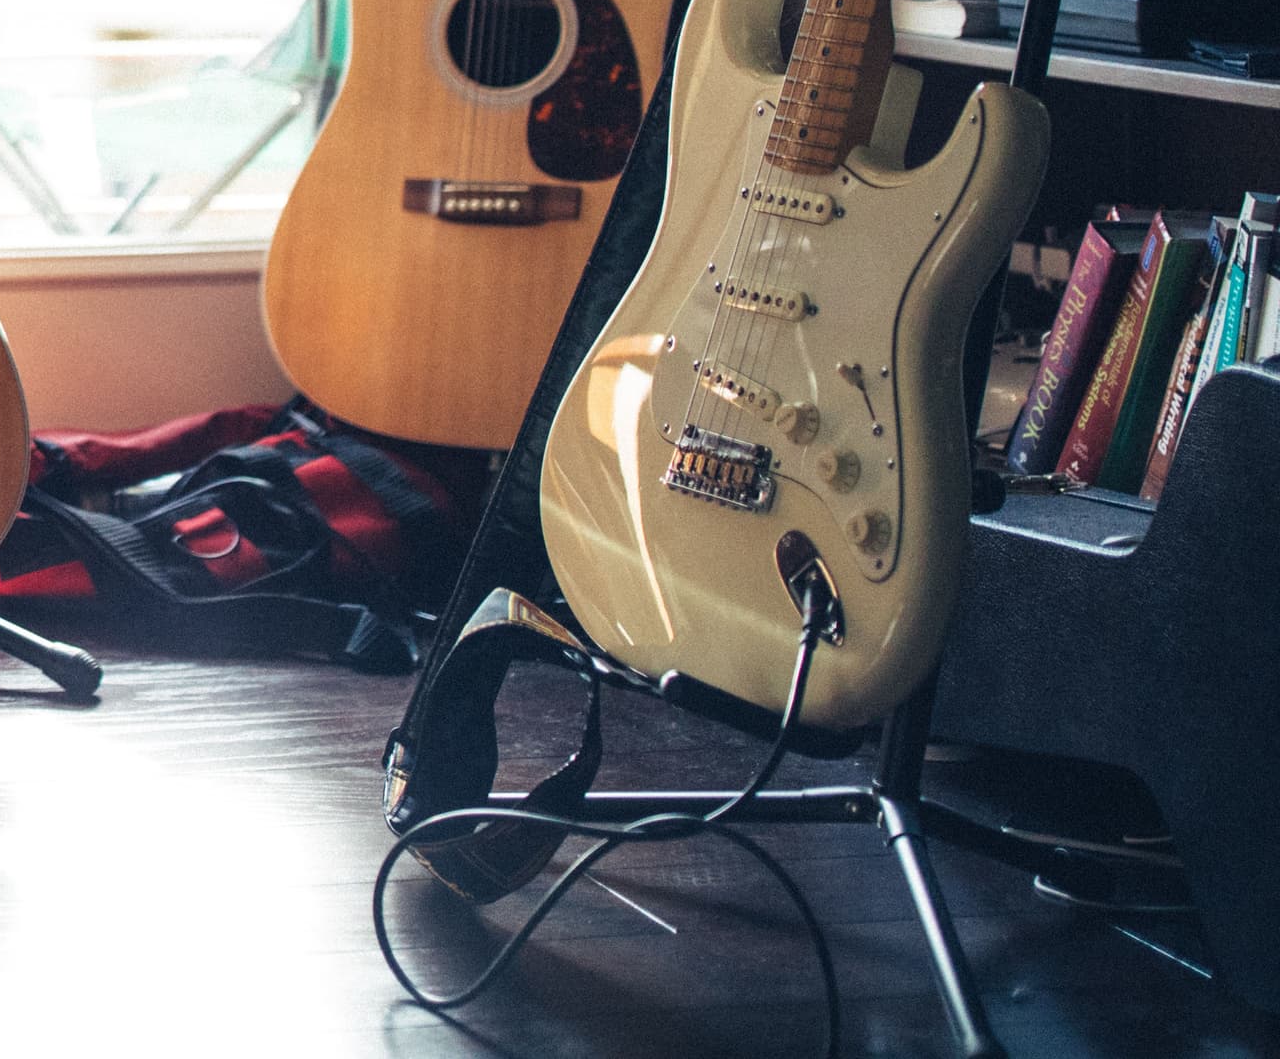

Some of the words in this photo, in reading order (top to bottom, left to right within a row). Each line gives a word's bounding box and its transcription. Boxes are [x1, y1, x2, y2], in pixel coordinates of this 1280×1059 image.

[1049, 283, 1087, 362] Physics
[1108, 302, 1142, 389] Fundamentals
[1176, 313, 1203, 392] Technical
[1022, 366, 1060, 442] BOOK
[1077, 365, 1108, 431] Systems
[1102, 389, 1112, 408] of
[1157, 391, 1183, 456] Writing
